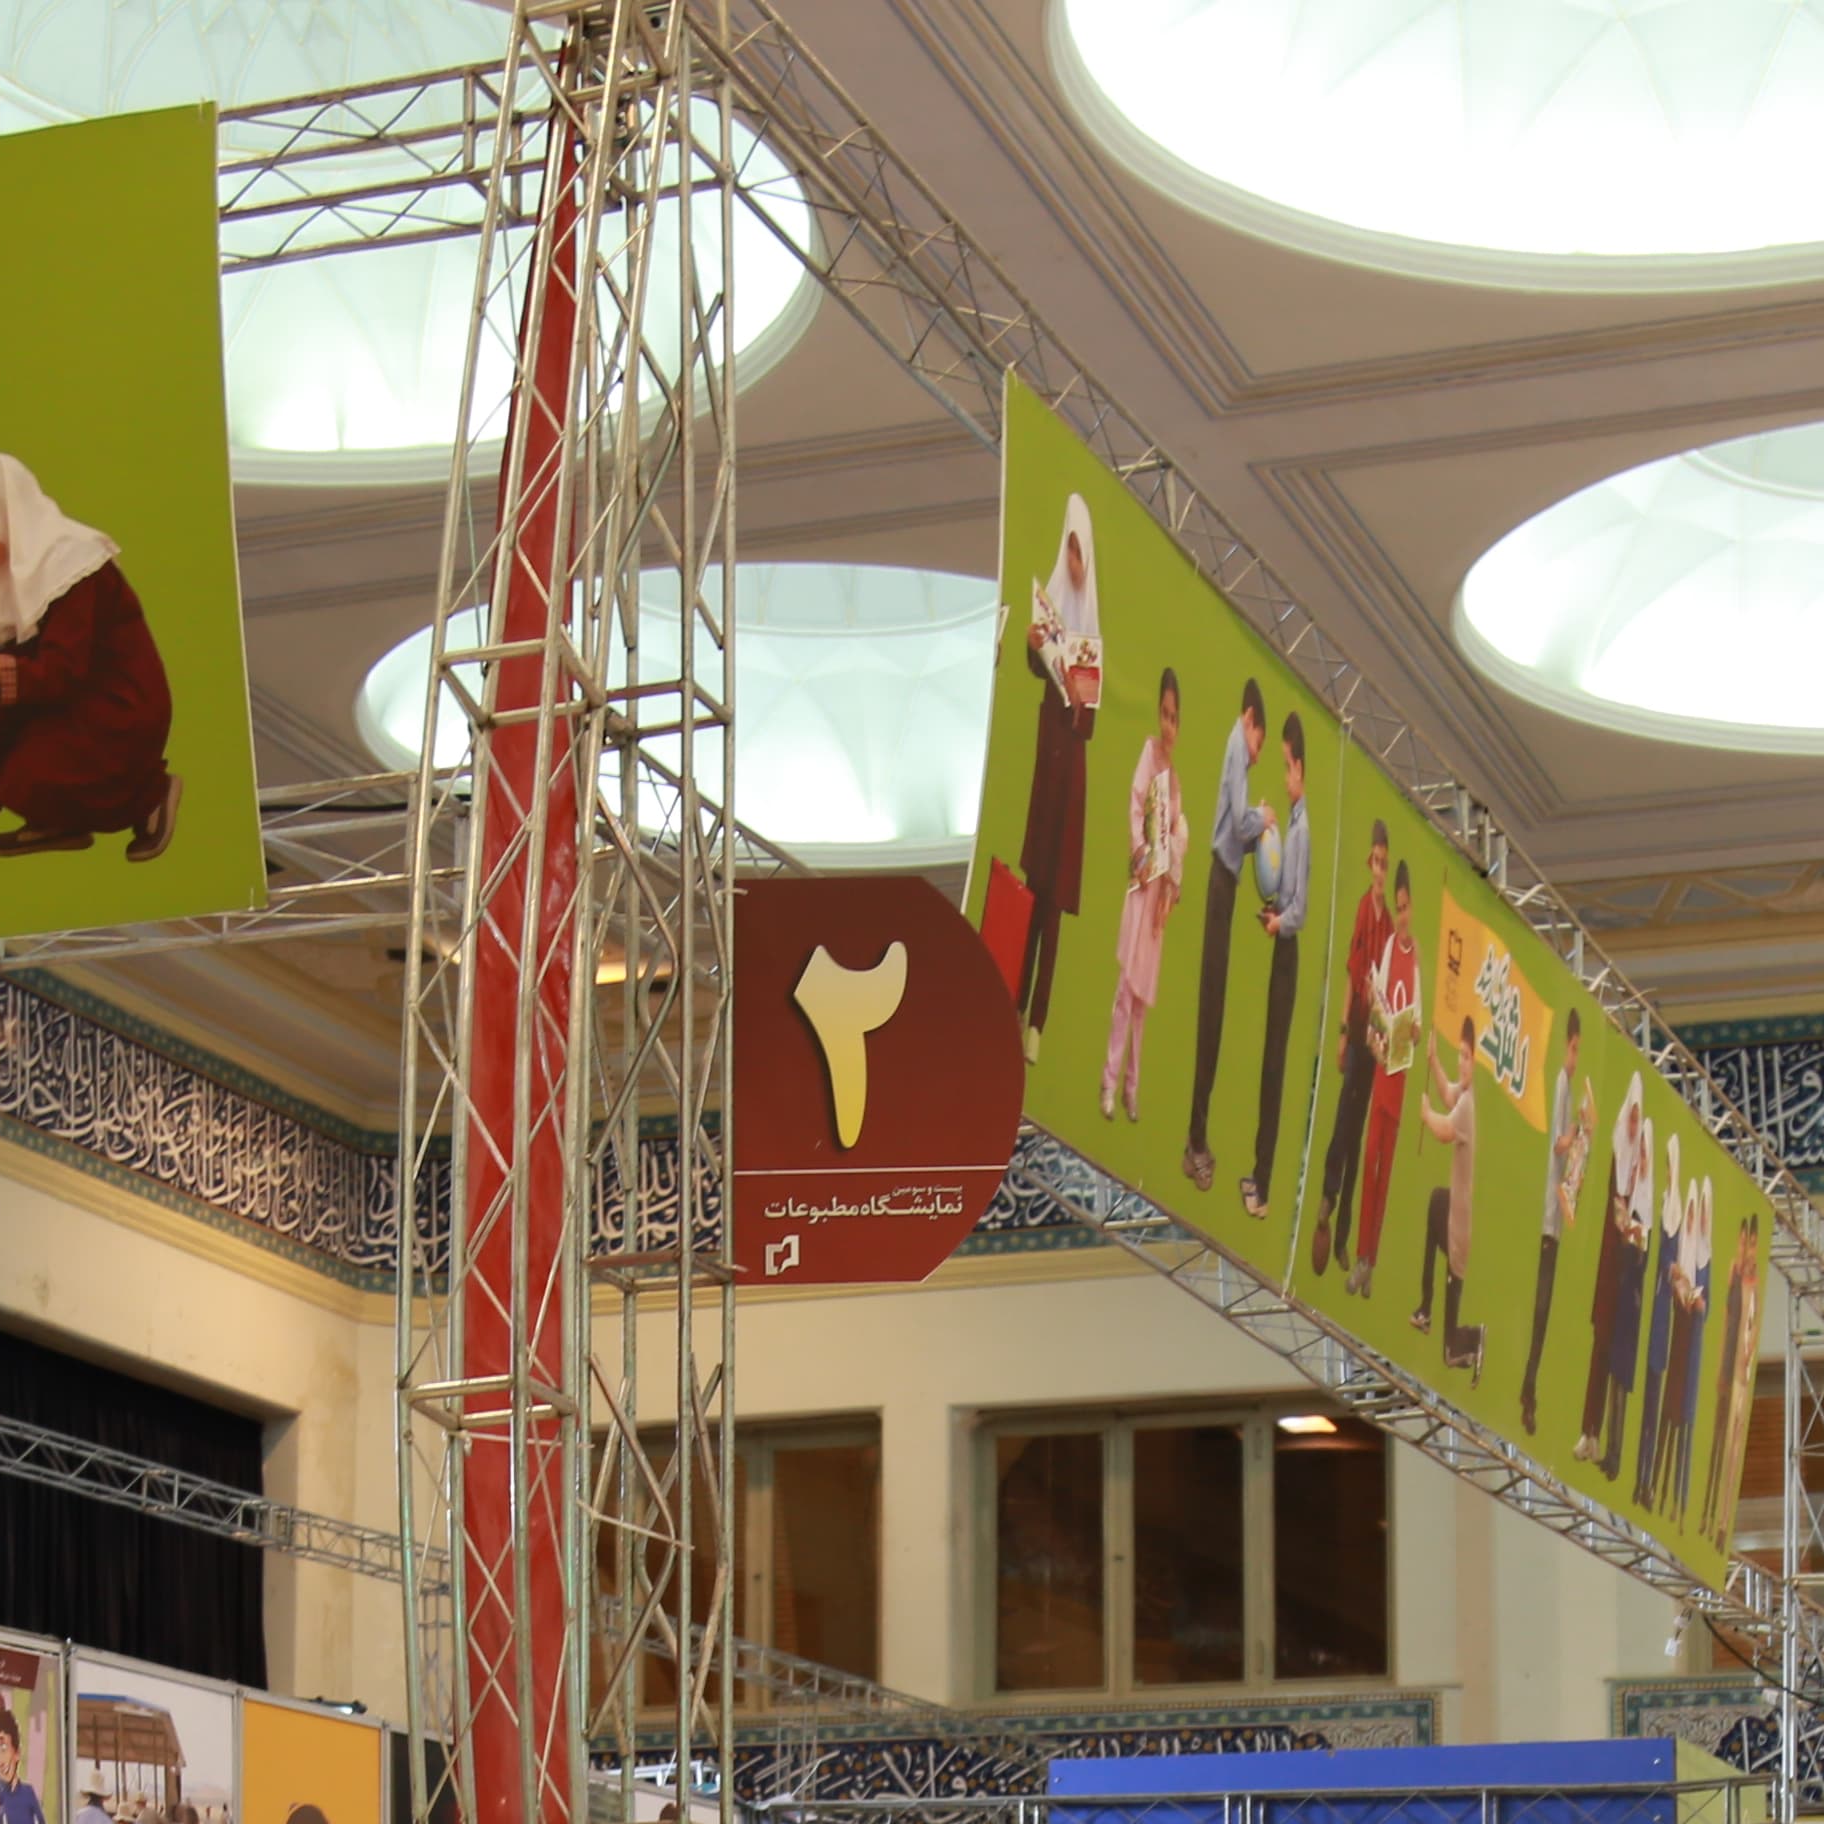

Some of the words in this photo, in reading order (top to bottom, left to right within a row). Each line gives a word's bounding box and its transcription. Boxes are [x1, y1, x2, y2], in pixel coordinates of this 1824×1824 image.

[793, 940, 909, 1150] ۲
[892, 1184, 927, 1198] سومین
[933, 1183, 964, 1194] بیست
[763, 1196, 860, 1225] مطبوعات
[860, 1193, 964, 1221] نمایشگاه
